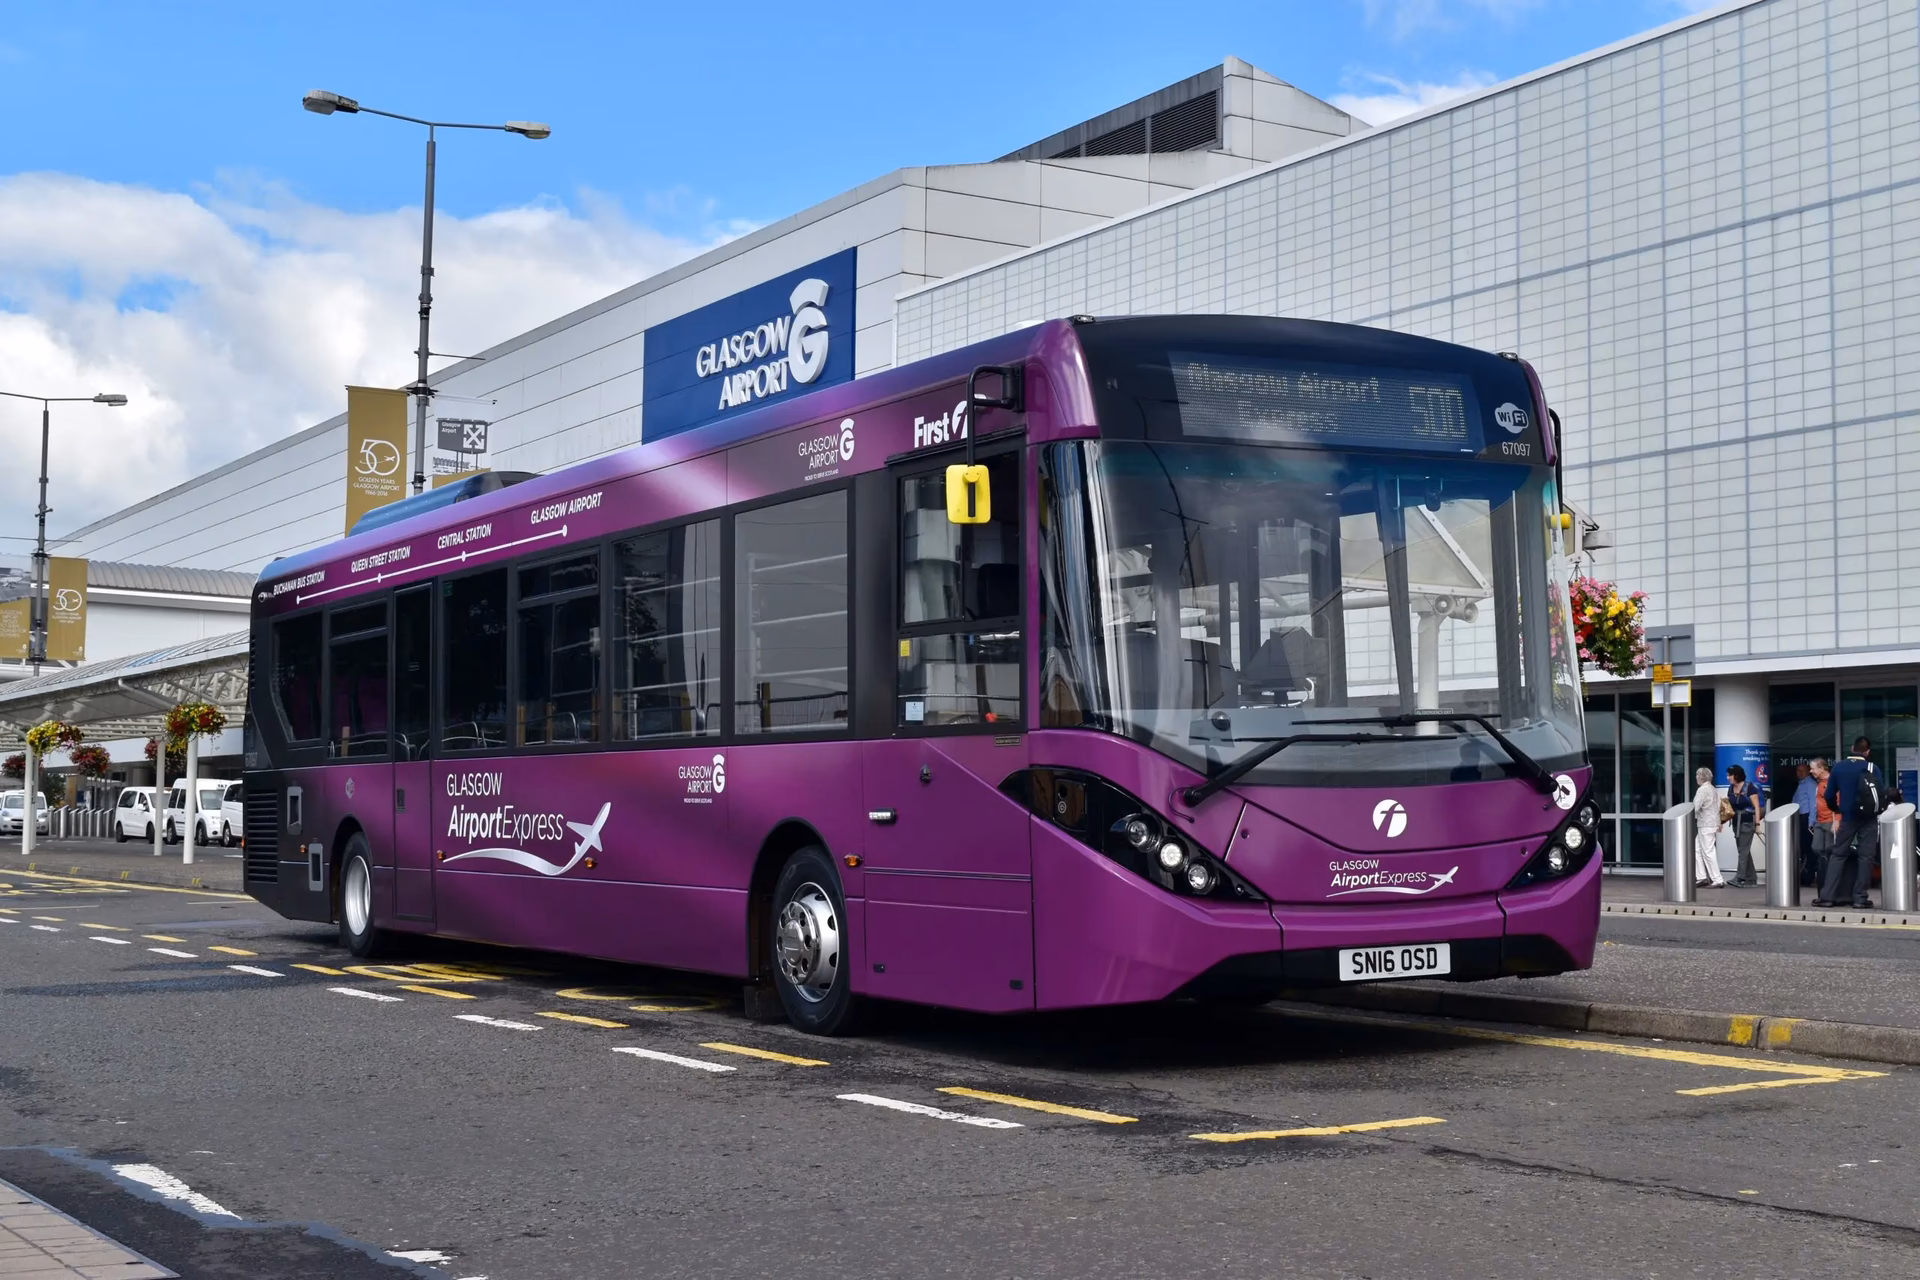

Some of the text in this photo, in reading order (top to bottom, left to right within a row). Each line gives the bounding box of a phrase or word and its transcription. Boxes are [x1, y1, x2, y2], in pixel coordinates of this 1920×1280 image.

[696, 316, 790, 378] GLASGOW
[718, 357, 789, 410] AIRPORT
[1298, 371, 1380, 403] Airport
[1409, 386, 1466, 438] 500
[914, 412, 950, 448] First
[355, 439, 400, 476] 50
[798, 433, 839, 457] GLASGOW
[1502, 441, 1531, 456] 67097
[808, 449, 839, 469] AIRPORT
[530, 492, 603, 524] GLASGOW AIRPORT
[437, 523, 492, 549] CENTRAL STATION
[351, 546, 411, 573] QUEEN STREET STATION
[273, 570, 325, 595] BUCHANAN BUS STATION
[446, 772, 502, 796] GLASGOW
[678, 765, 712, 779] GLASGOW
[687, 780, 712, 793] AIRPORT
[447, 805, 564, 846] AirportExpress
[1329, 859, 1379, 872] GLASGOW
[1331, 870, 1427, 888] AirportExpress
[1351, 947, 1438, 975] SN16 OSD
